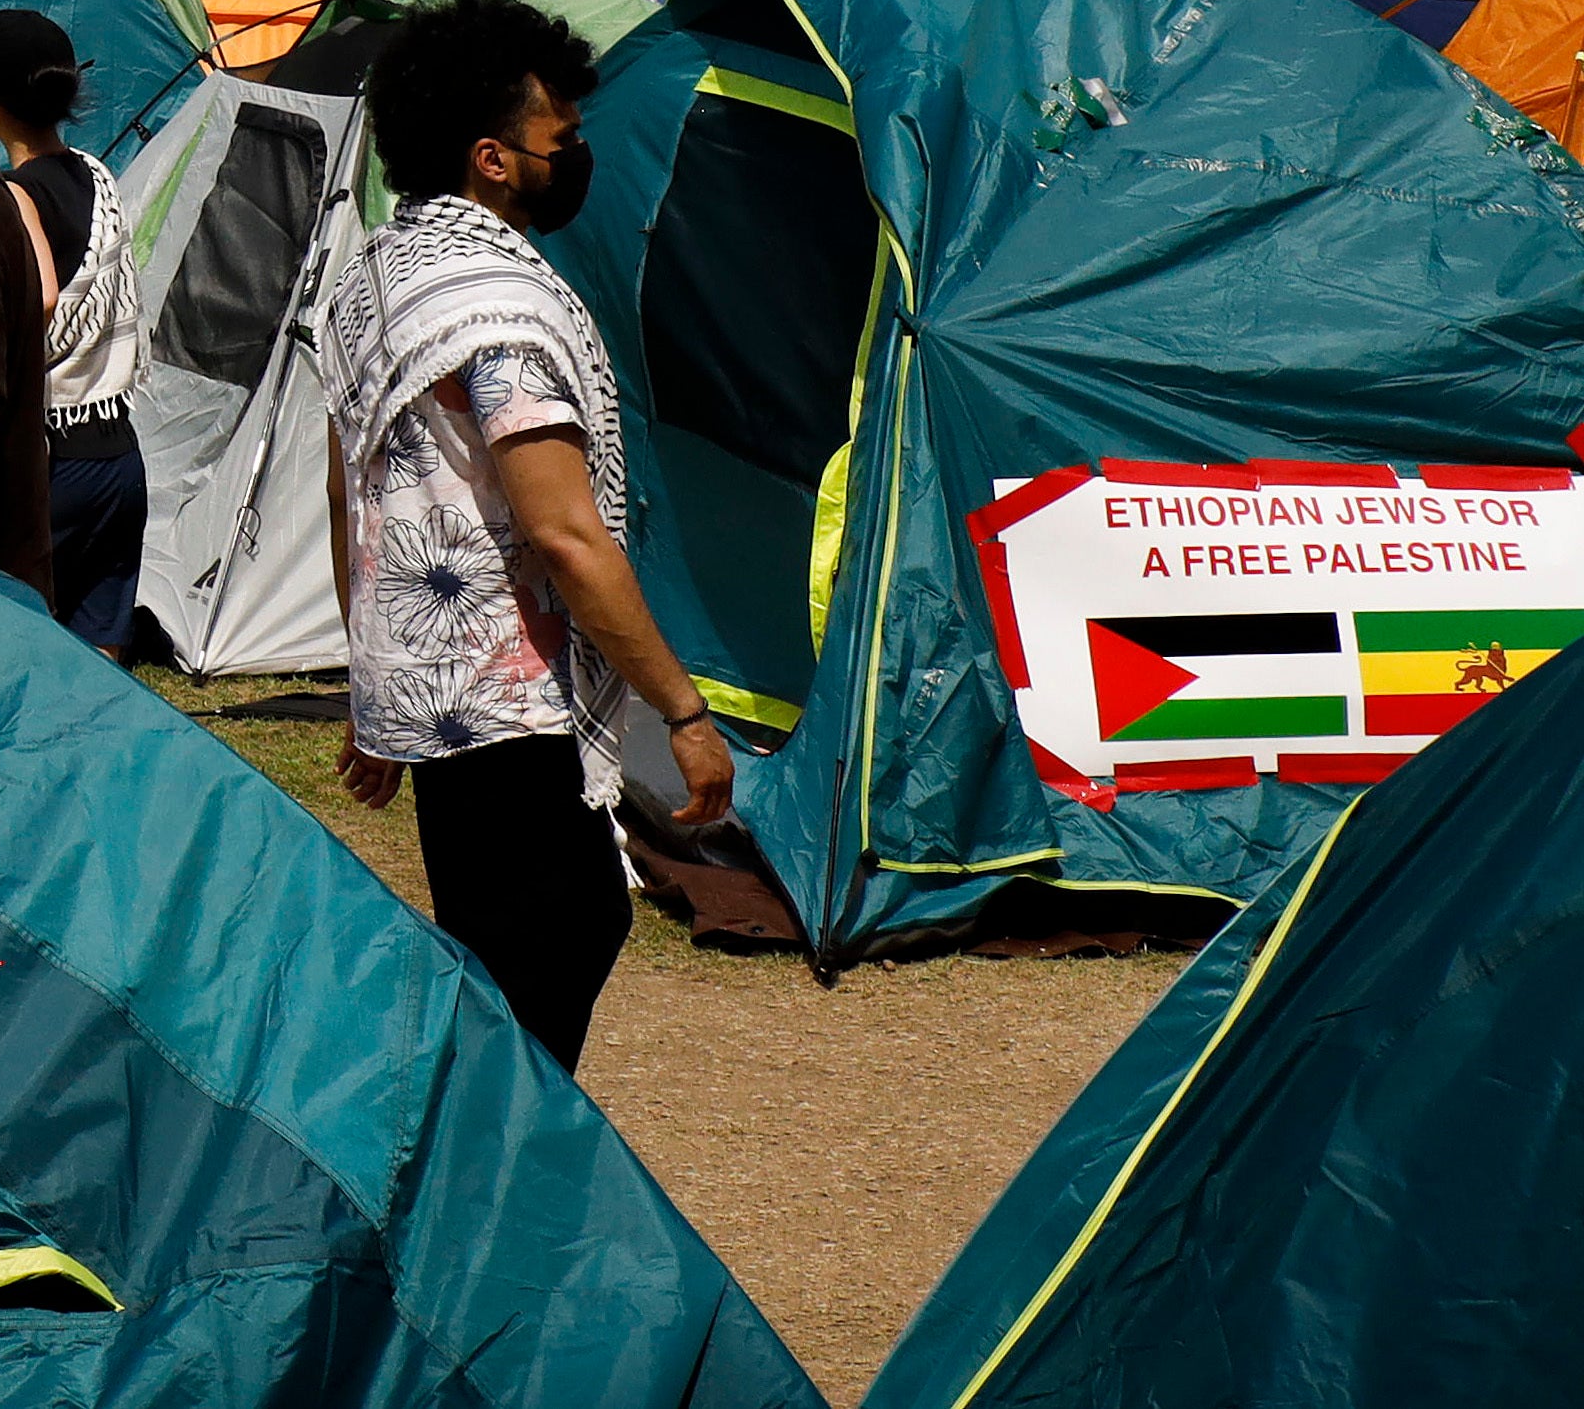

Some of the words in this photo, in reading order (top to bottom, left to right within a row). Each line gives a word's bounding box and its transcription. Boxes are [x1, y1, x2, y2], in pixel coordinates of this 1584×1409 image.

[1104, 496, 1324, 528] ETHIOPIAN
[1335, 497, 1447, 525] JEWS
[1454, 498, 1540, 526] FOR
[1142, 547, 1170, 578] A
[1183, 545, 1293, 576] FREE
[1303, 542, 1528, 574] PALESTINE
